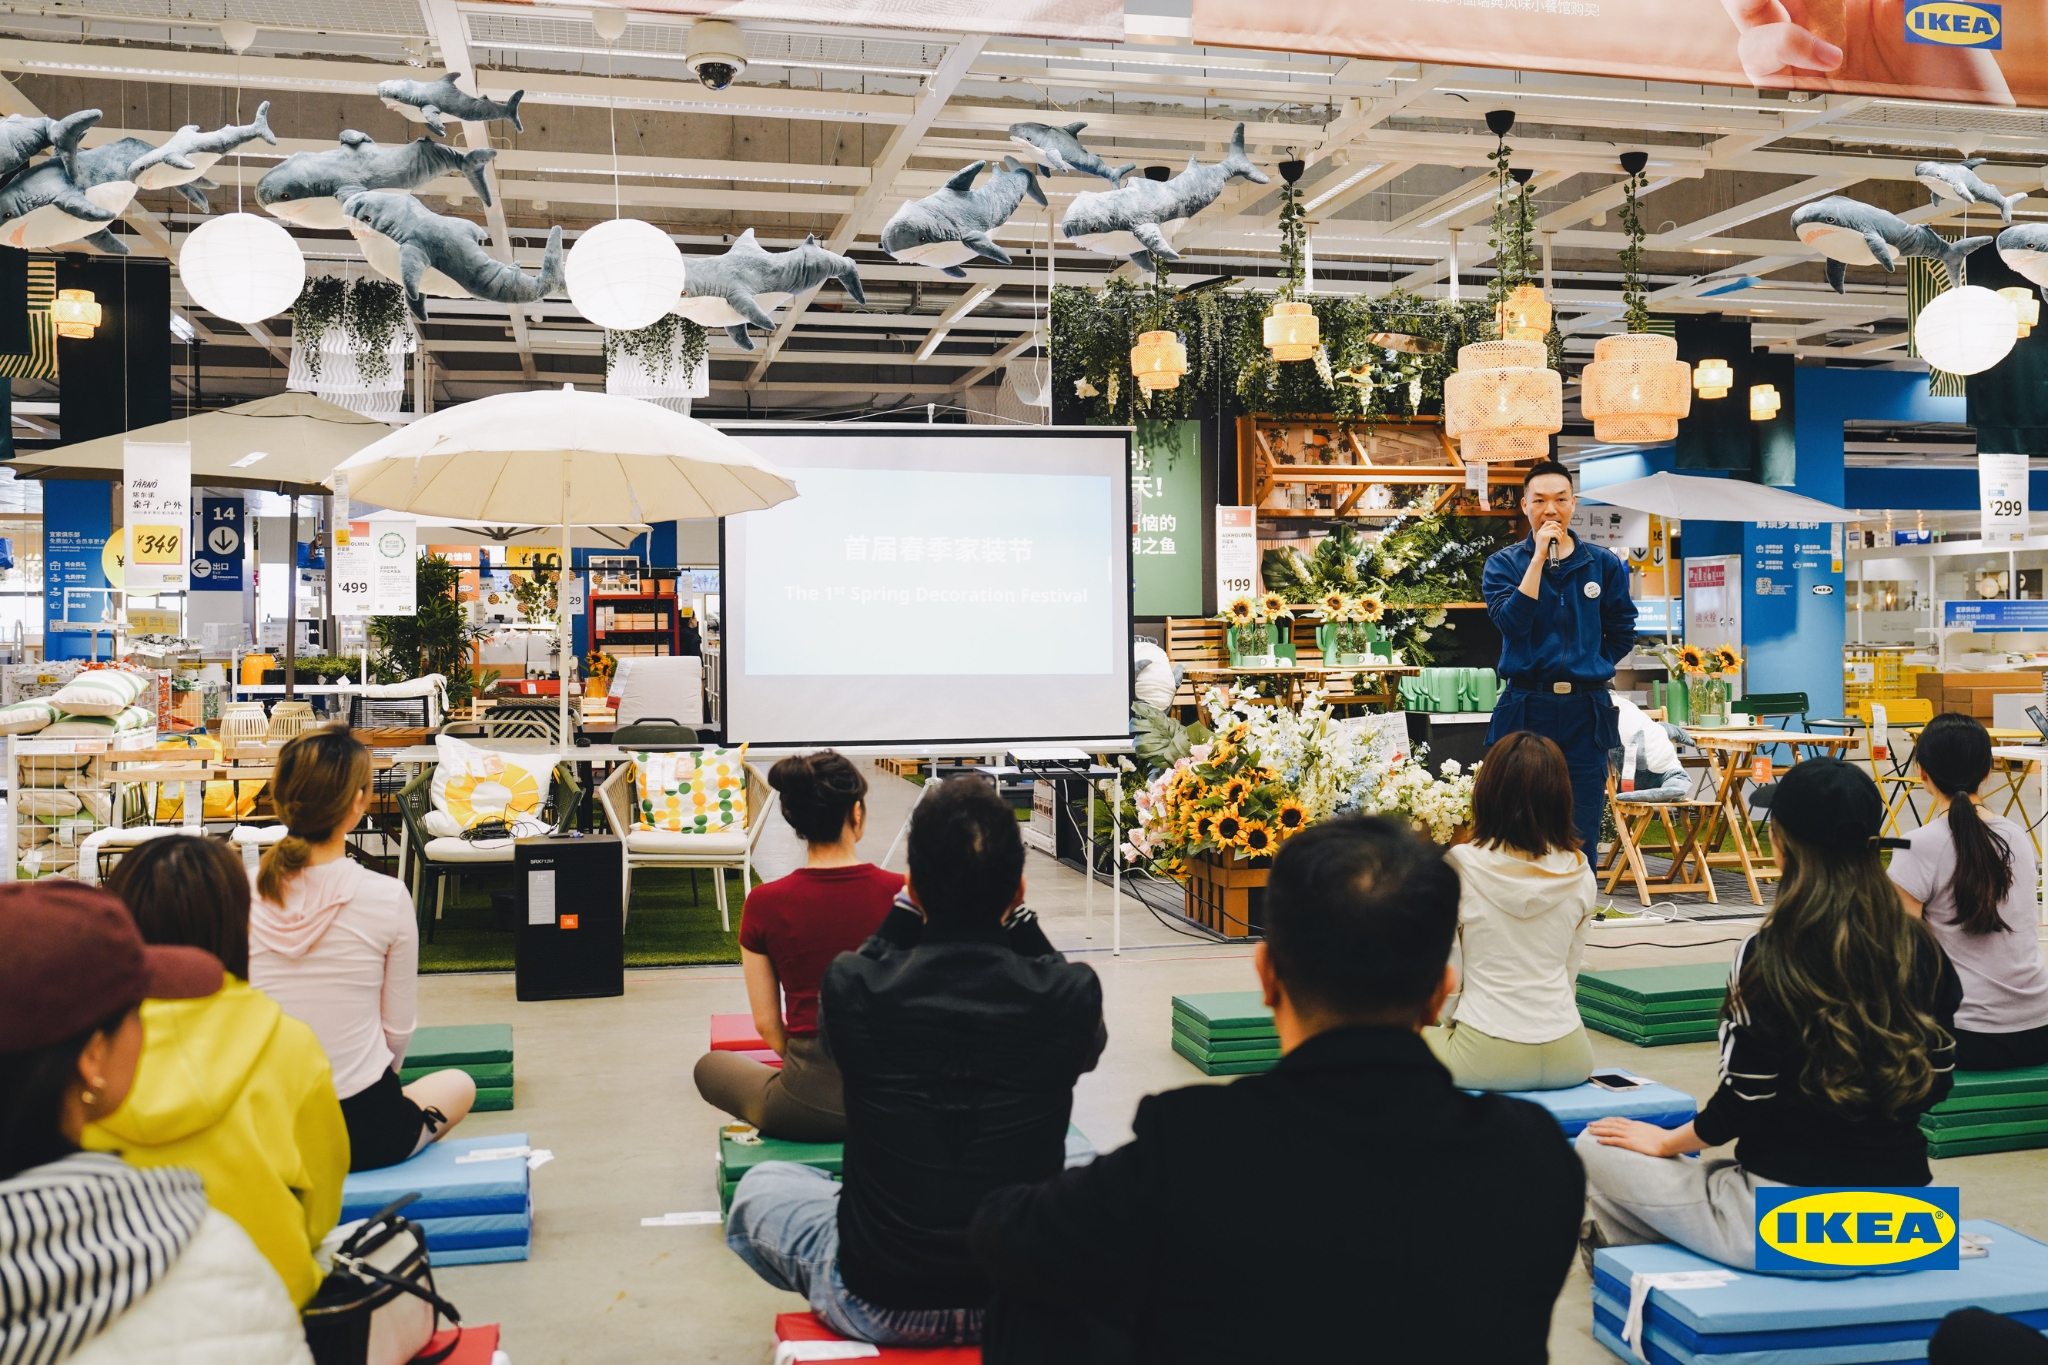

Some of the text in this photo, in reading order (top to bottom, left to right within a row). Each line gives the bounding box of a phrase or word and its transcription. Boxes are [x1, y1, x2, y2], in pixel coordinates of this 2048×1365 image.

[1410, 0, 1600, 17] 面瑞典风味小餐馆购买!
[1914, 11, 1994, 35] IKEA
[213, 507, 236, 520] 14
[1988, 500, 2022, 516] ¥299
[137, 534, 179, 554] ¥349
[844, 535, 1034, 564] 首届春季家装节
[212, 563, 229, 571] 出口
[338, 582, 368, 593] ¥499
[1222, 578, 1250, 591] ¥199
[784, 585, 819, 600] The
[850, 586, 910, 605] Spring
[916, 587, 1015, 602] Decoration
[1021, 587, 1088, 603] Festival
